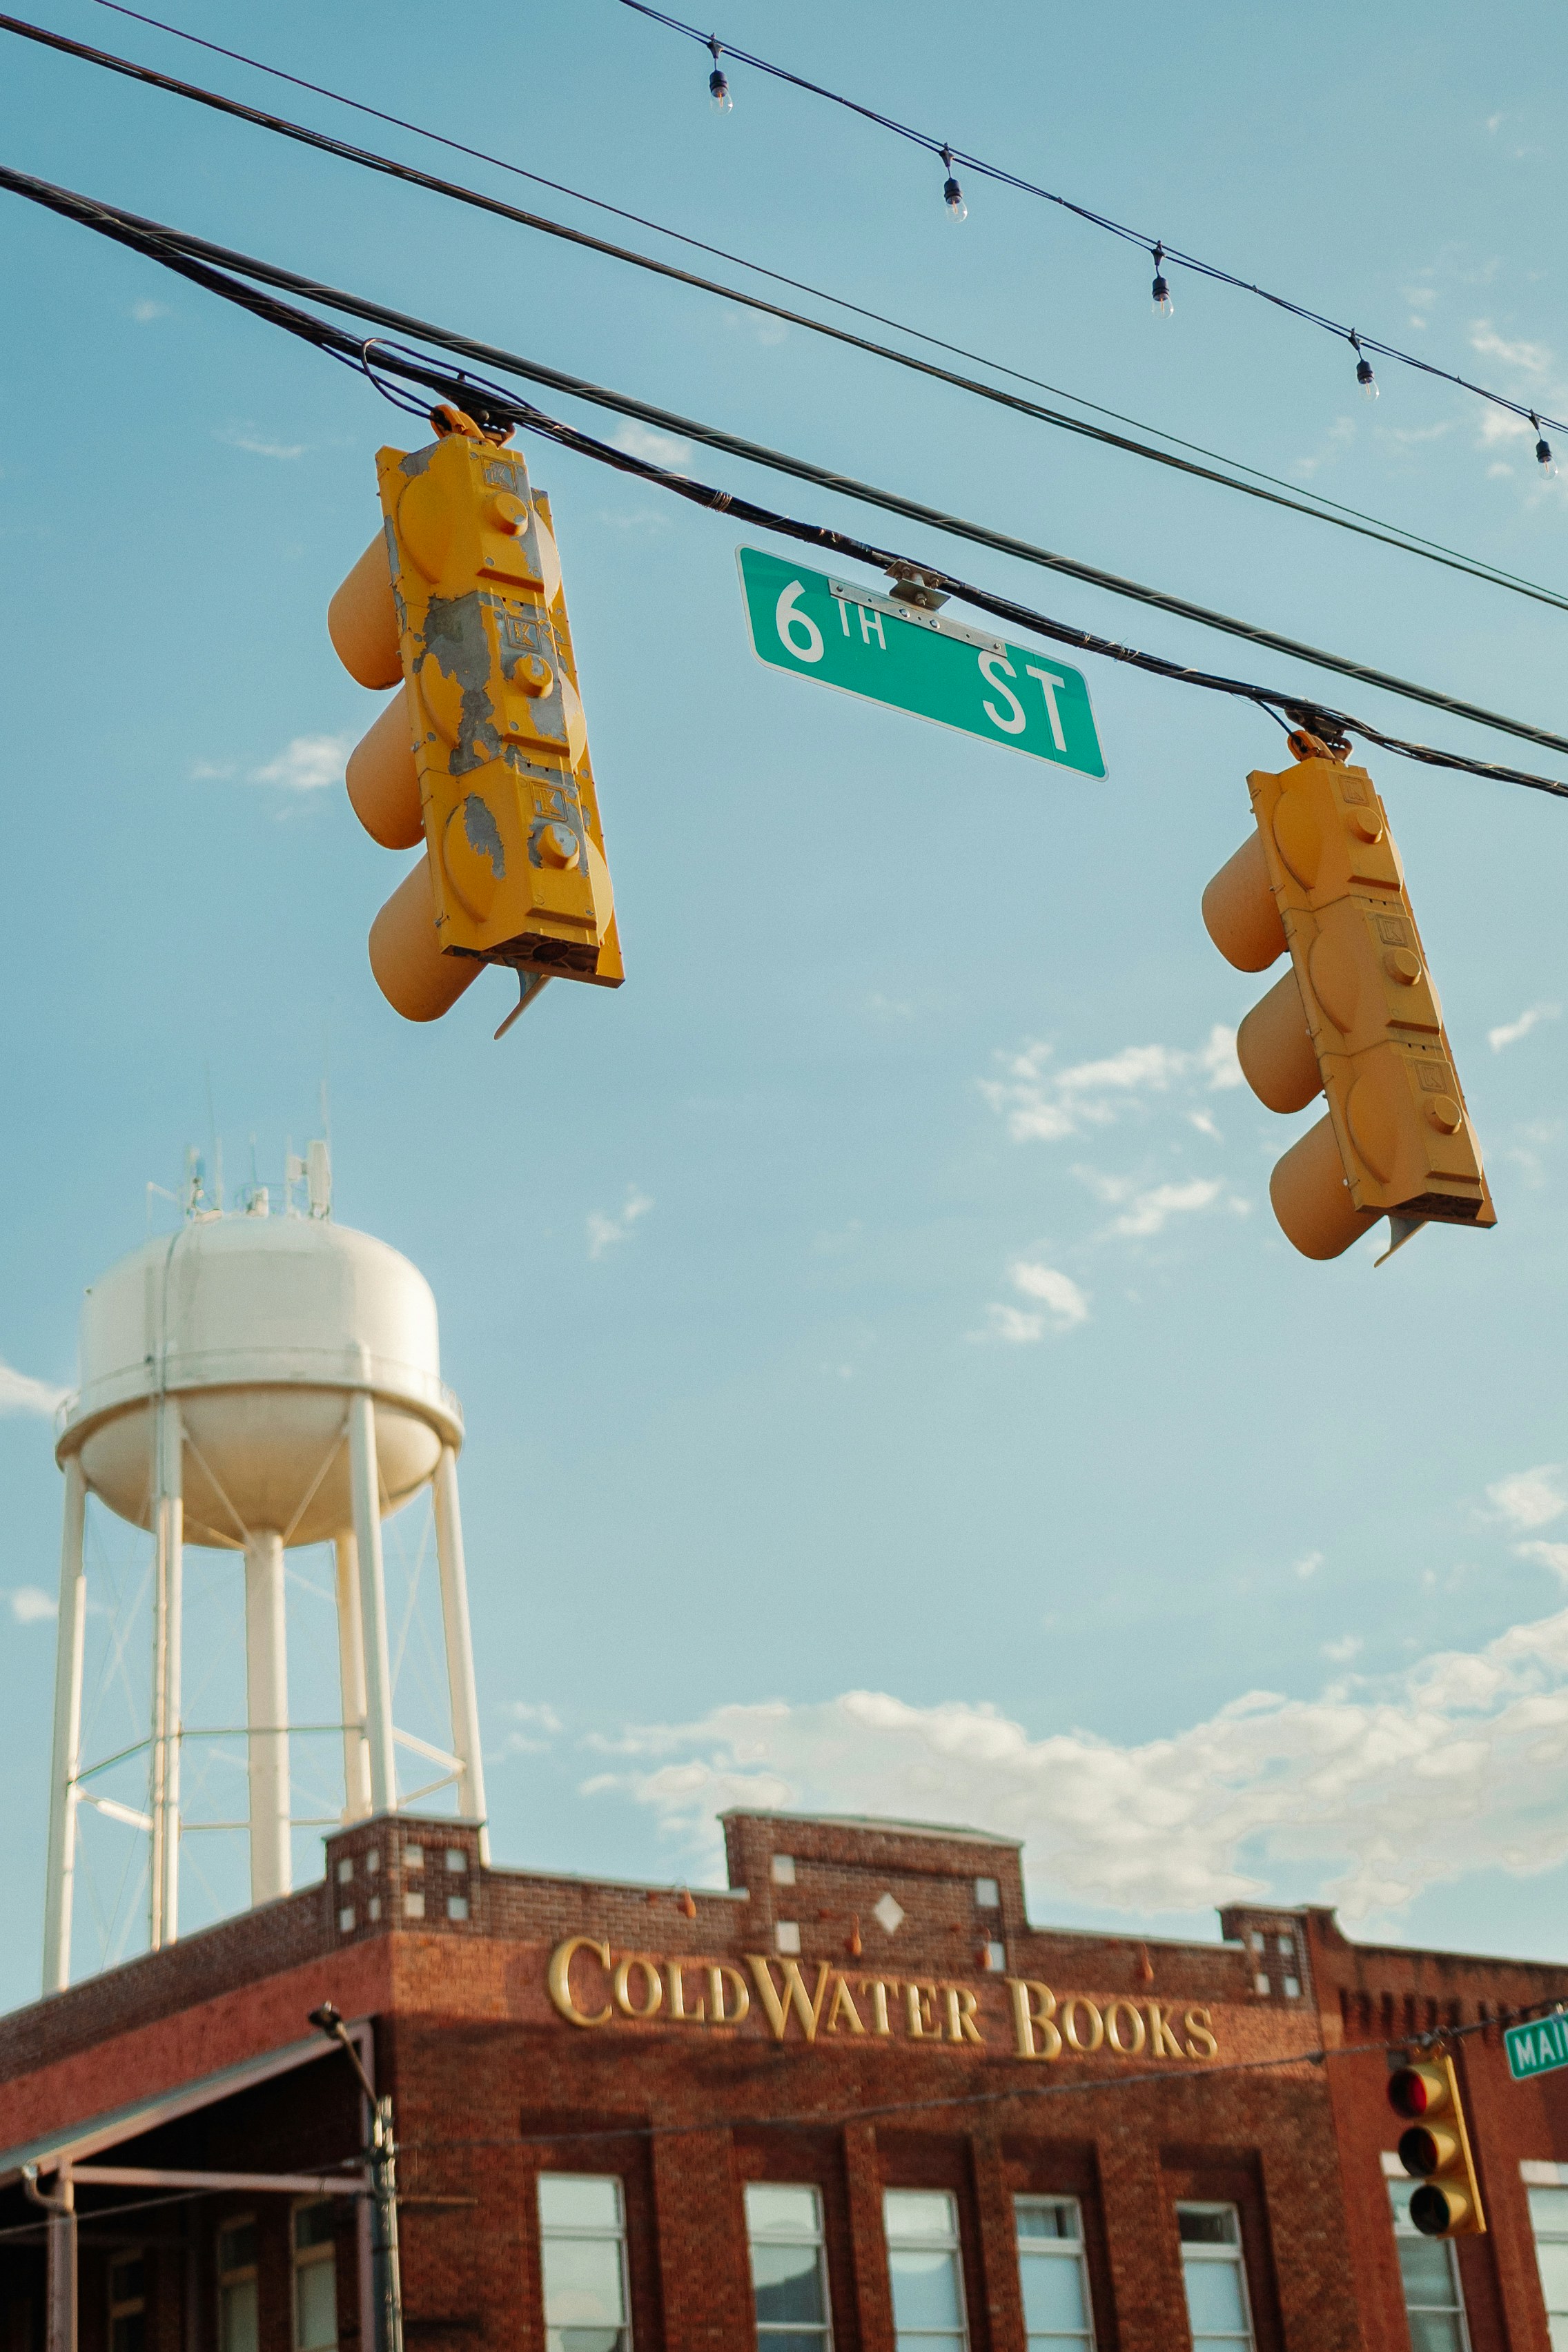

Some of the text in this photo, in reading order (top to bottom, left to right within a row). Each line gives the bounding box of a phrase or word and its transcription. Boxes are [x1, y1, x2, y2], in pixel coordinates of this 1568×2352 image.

[776, 579, 1067, 752] 6TH ST
[1005, 1977, 1218, 2061] BOOKS
